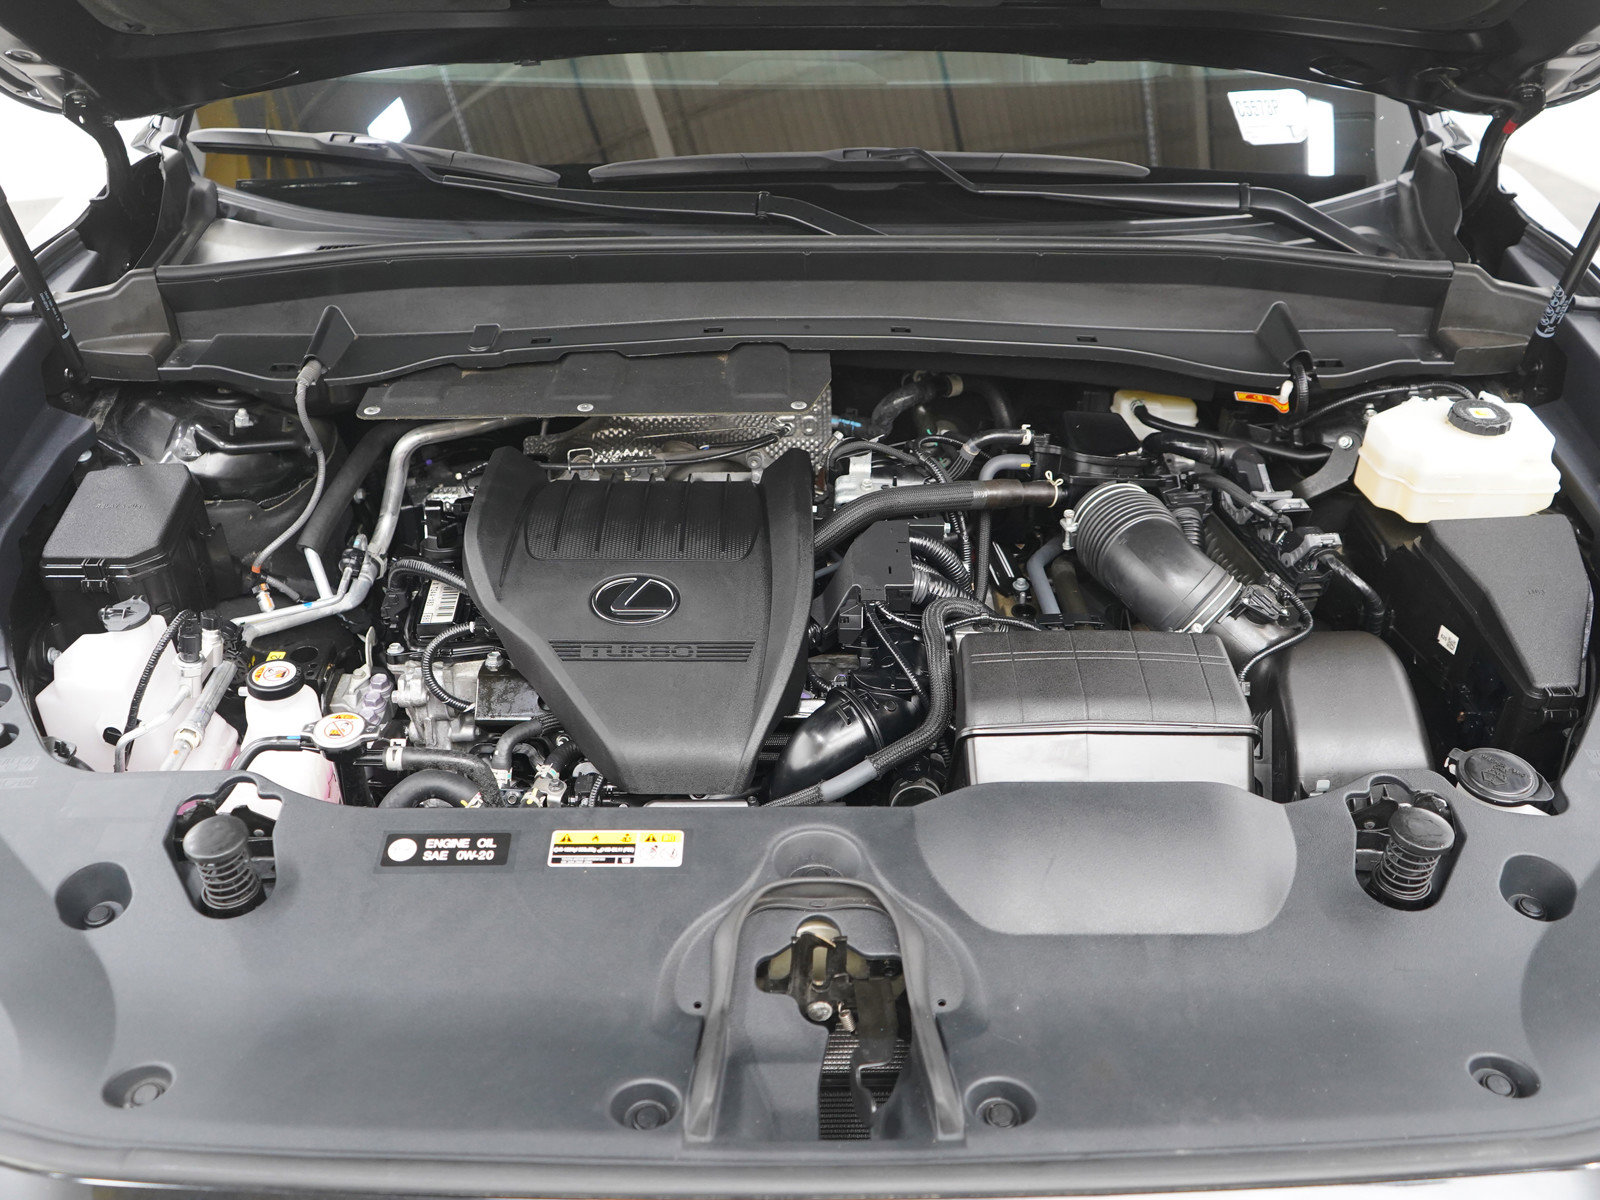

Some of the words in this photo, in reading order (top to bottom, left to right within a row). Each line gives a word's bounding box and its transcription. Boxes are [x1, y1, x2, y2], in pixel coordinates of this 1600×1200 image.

[583, 644, 694, 658] TURBO
[425, 838, 471, 849] ENGINE
[476, 837, 497, 849] OIL
[422, 850, 449, 861] SAE
[455, 849, 495, 861] 0W-20
